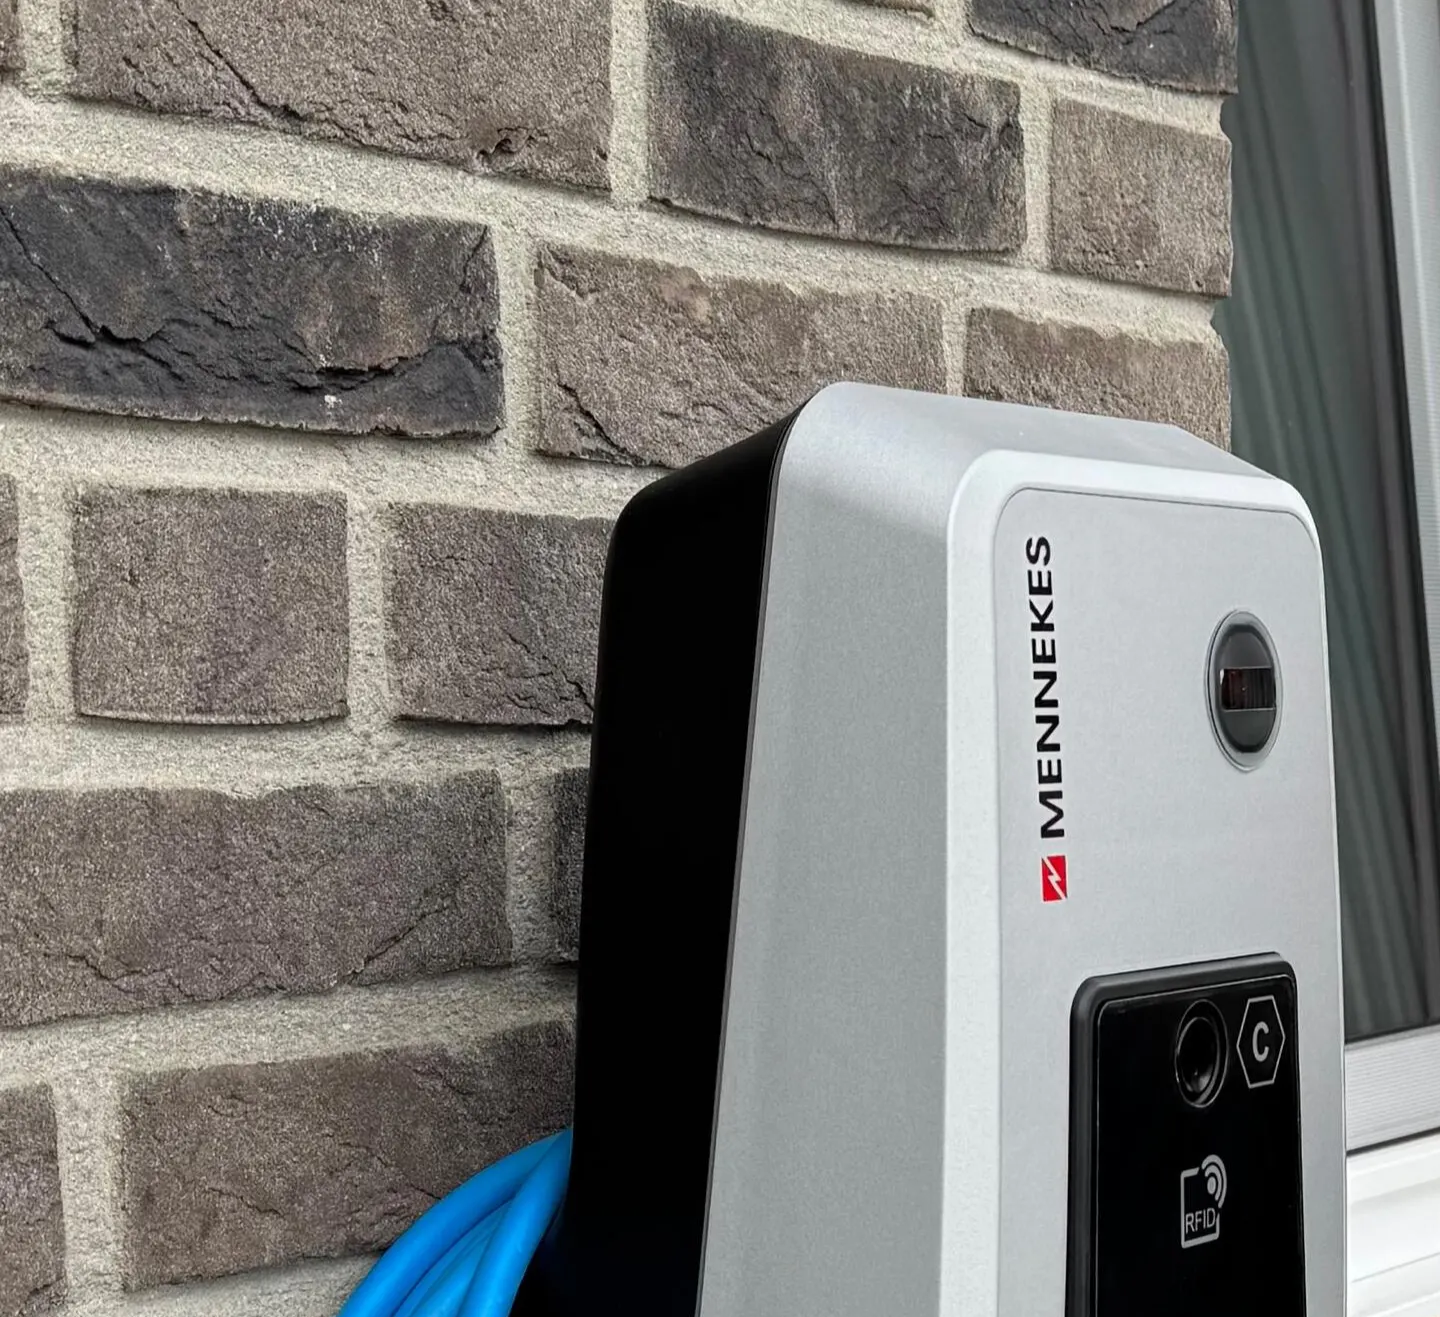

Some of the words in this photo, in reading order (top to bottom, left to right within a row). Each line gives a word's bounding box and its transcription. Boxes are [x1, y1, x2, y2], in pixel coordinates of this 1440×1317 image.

[1026, 536, 1065, 838] MENNEKES
[1252, 1021, 1270, 1062] C
[1184, 1207, 1217, 1234] RFID
